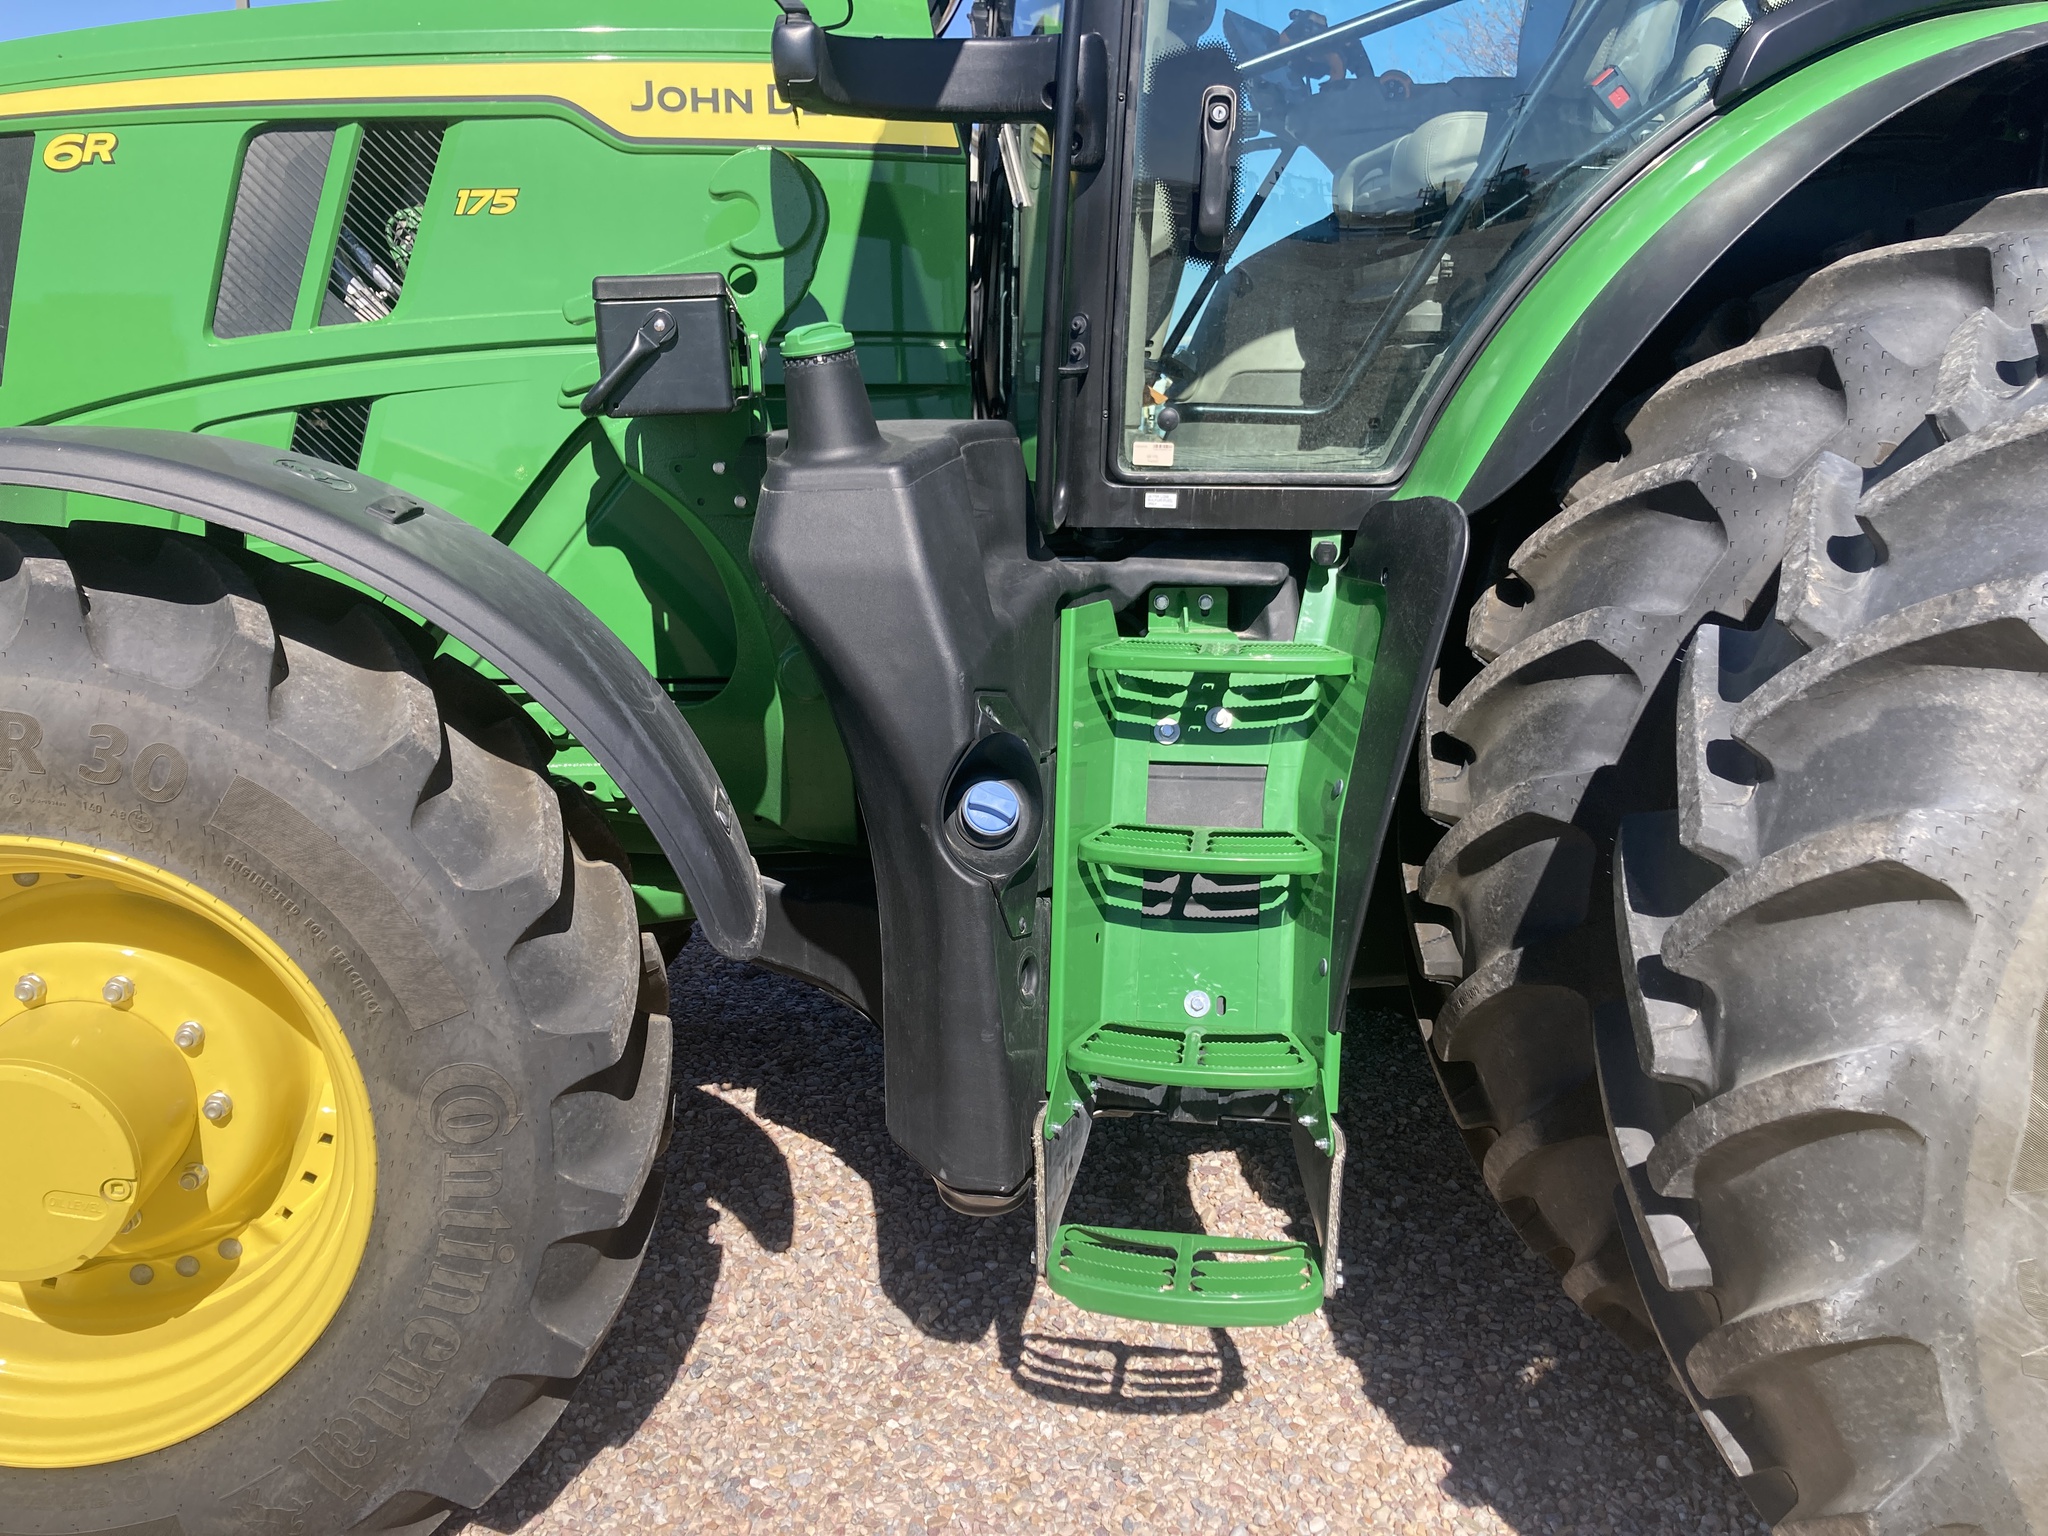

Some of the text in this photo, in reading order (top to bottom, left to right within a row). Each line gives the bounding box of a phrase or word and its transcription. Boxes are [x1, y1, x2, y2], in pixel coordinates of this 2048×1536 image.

[631, 80, 753, 114] JOHN
[43, 132, 119, 173] 6R
[454, 187, 520, 216] 175
[78, 723, 189, 803] 30
[223, 854, 383, 1016] ENGINEERED FOR EFFICIENCY
[288, 1062, 524, 1501] Continental
